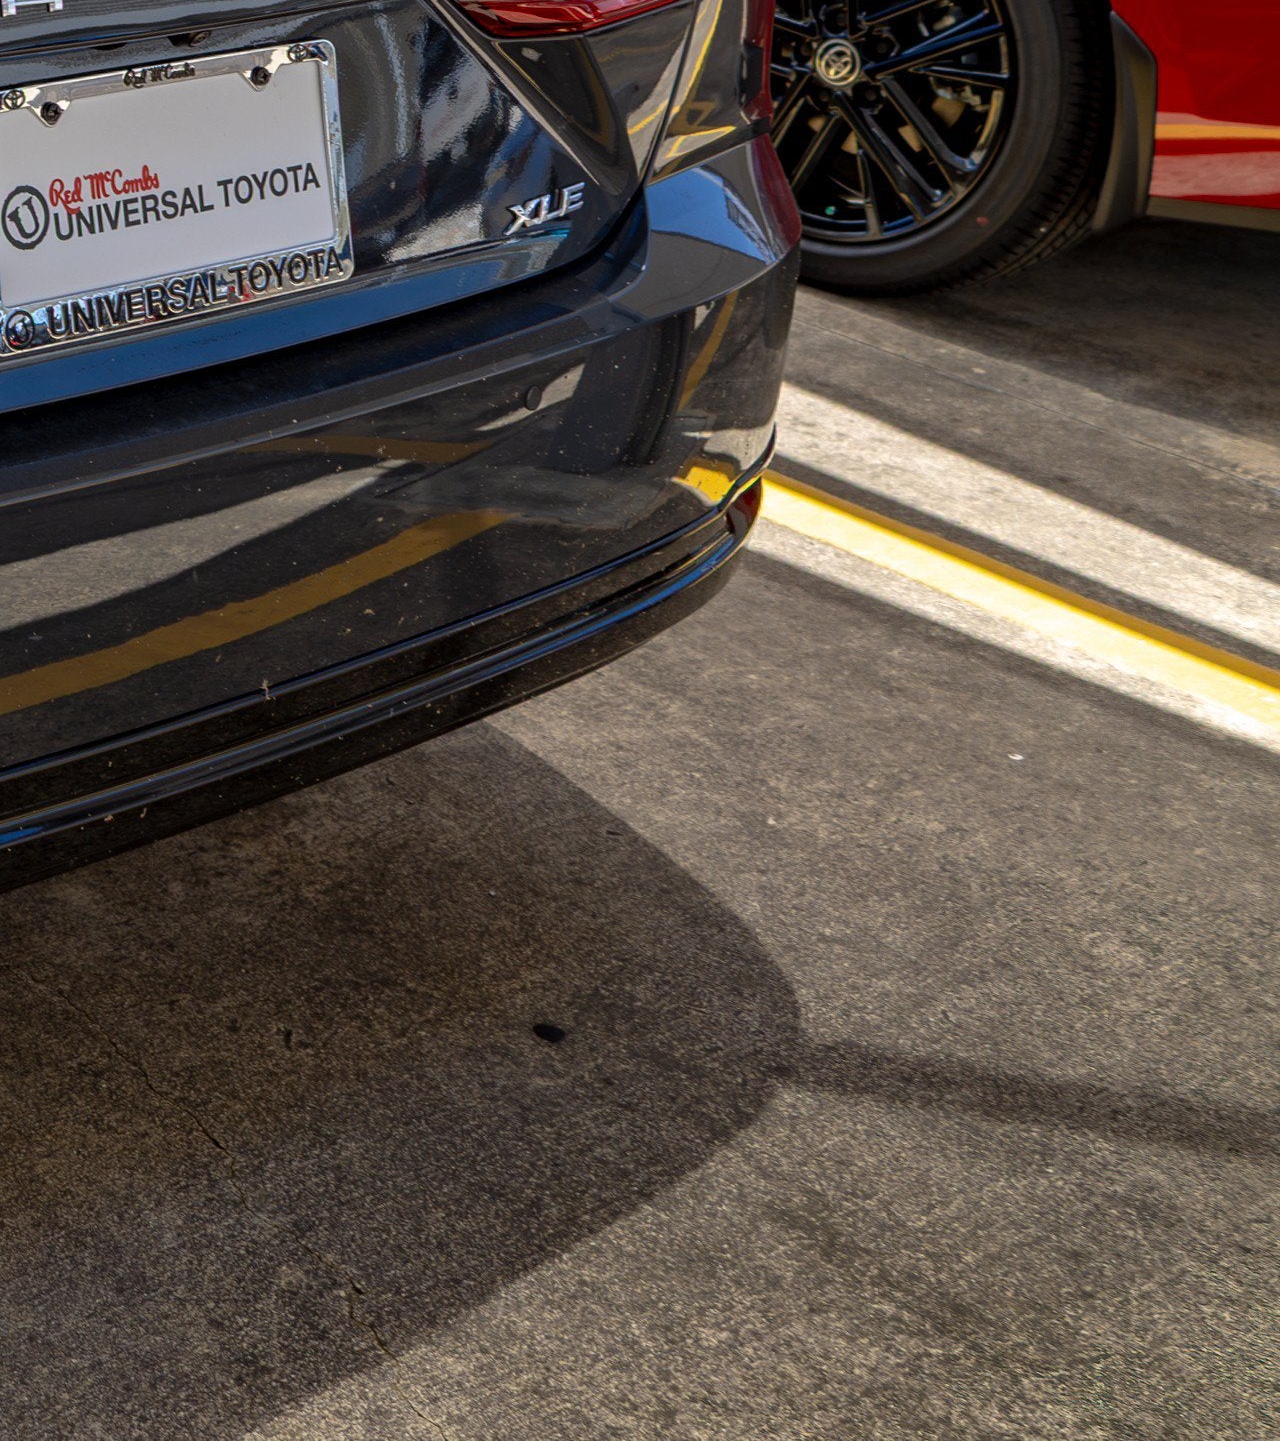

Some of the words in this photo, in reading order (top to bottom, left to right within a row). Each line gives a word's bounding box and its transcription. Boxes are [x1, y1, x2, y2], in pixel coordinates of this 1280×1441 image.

[49, 177, 83, 215] Red
[83, 164, 160, 200] McCombs
[53, 184, 215, 241] UNIVERSAL
[217, 162, 321, 208] TOYOTA
[503, 181, 586, 236] XLE
[46, 271, 229, 341] UNIVERSAL
[229, 246, 344, 299] TOYOTA
